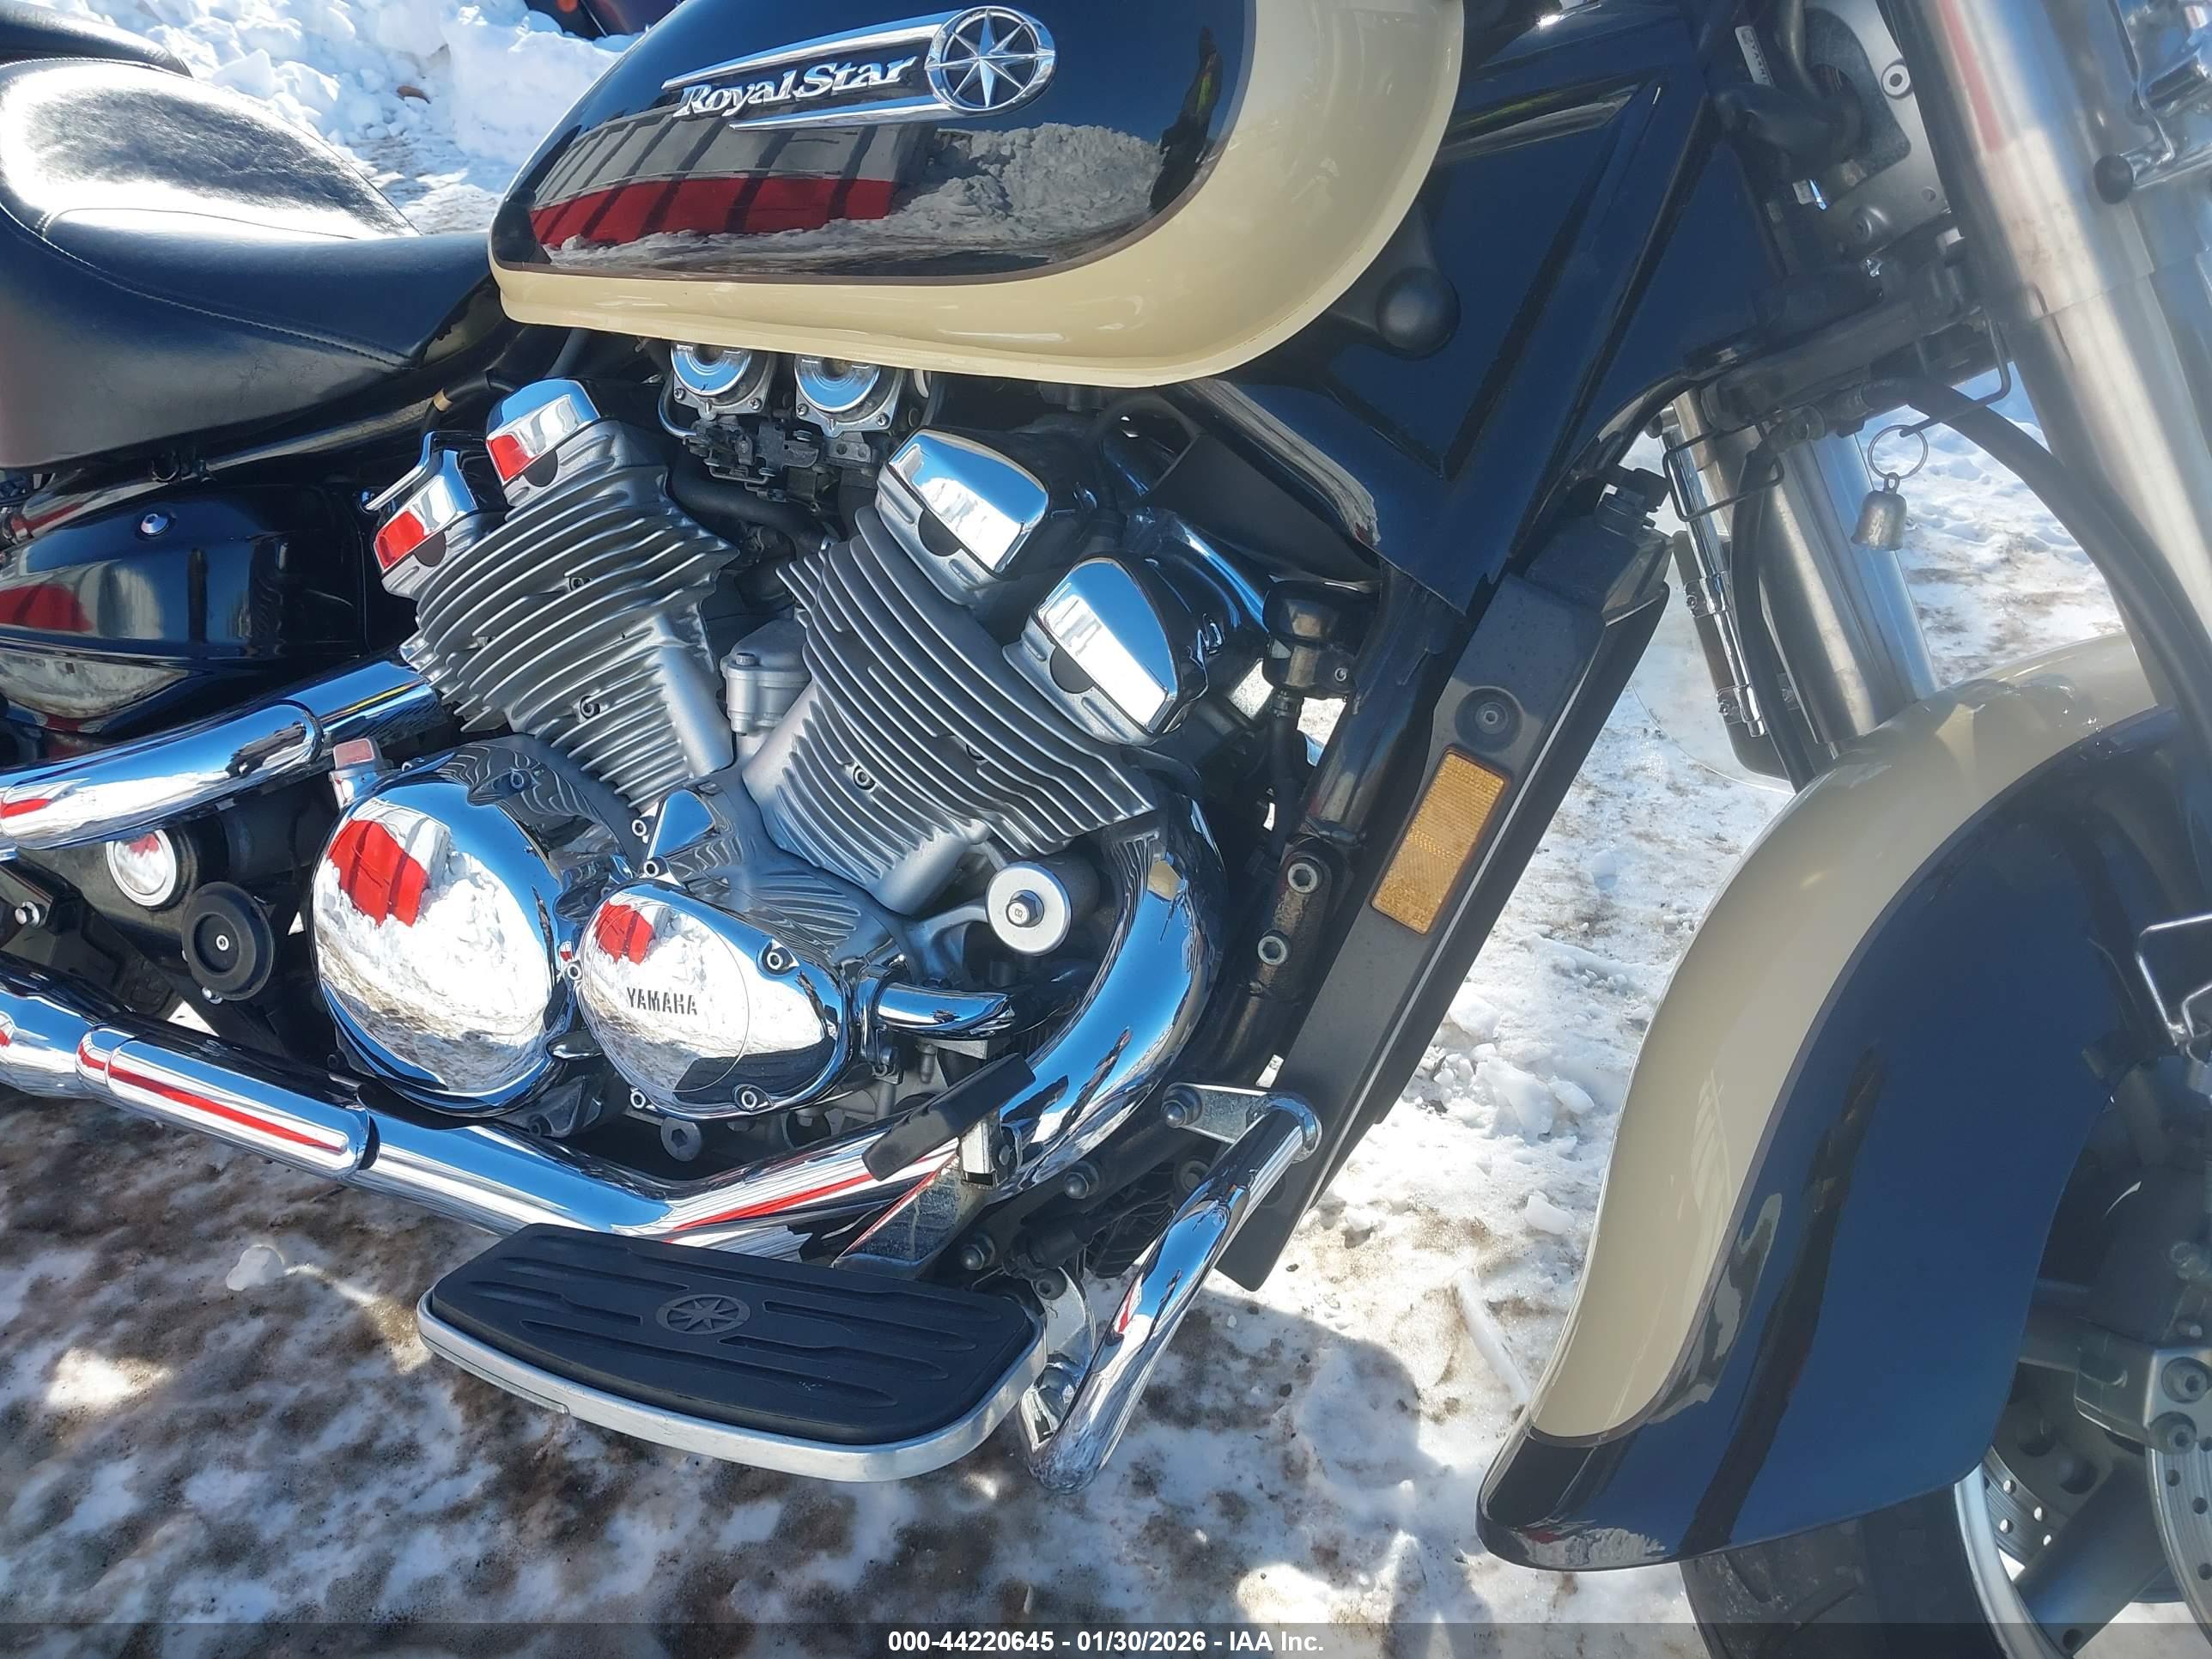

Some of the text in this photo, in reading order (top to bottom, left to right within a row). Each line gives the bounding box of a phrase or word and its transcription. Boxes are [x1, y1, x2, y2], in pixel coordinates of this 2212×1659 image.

[672, 56, 918, 118] Royal Star
[627, 987, 698, 1016] YAMAHA
